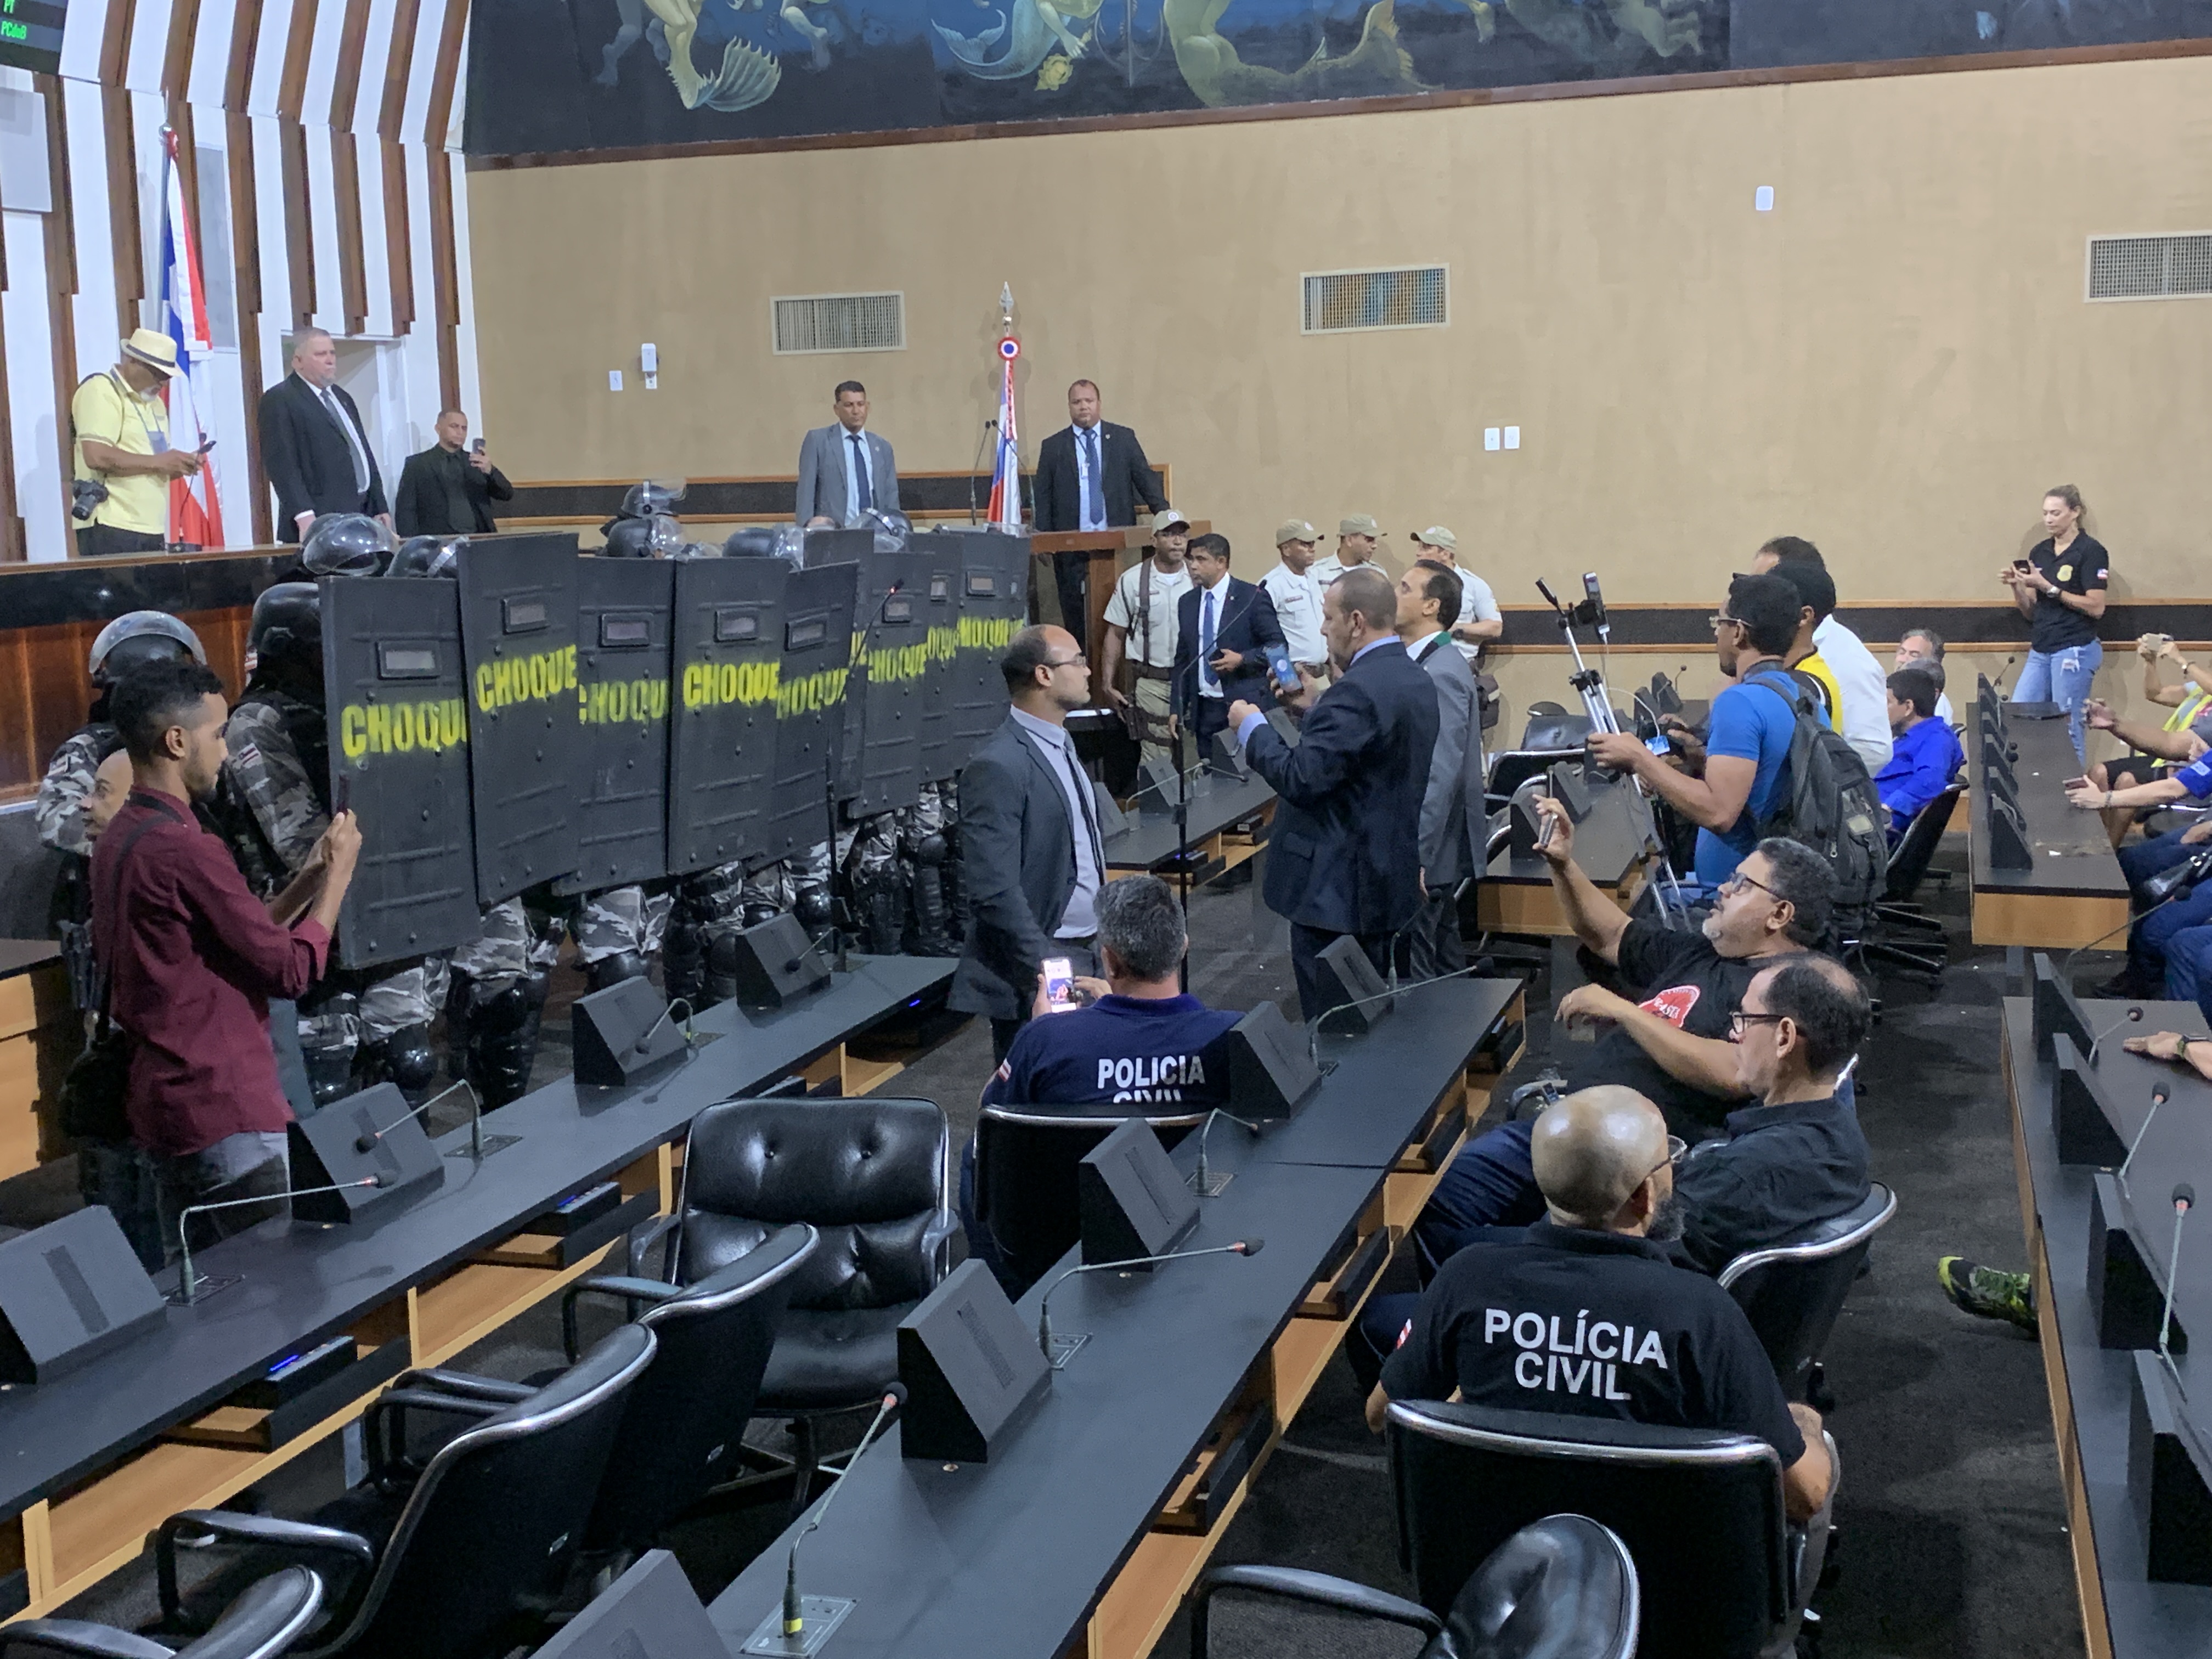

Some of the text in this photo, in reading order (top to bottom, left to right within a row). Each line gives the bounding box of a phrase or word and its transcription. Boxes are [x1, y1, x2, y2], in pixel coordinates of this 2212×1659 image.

[476, 644, 577, 712] CHOQUE
[683, 662, 780, 707] CHOQUE
[776, 668, 849, 720] HOQUE
[579, 680, 668, 726] HOQU
[1098, 1055, 1206, 1089] POLICIA
[1485, 1308, 1667, 1369] POLÍCIA
[1515, 1351, 1631, 1400] CIVIL
